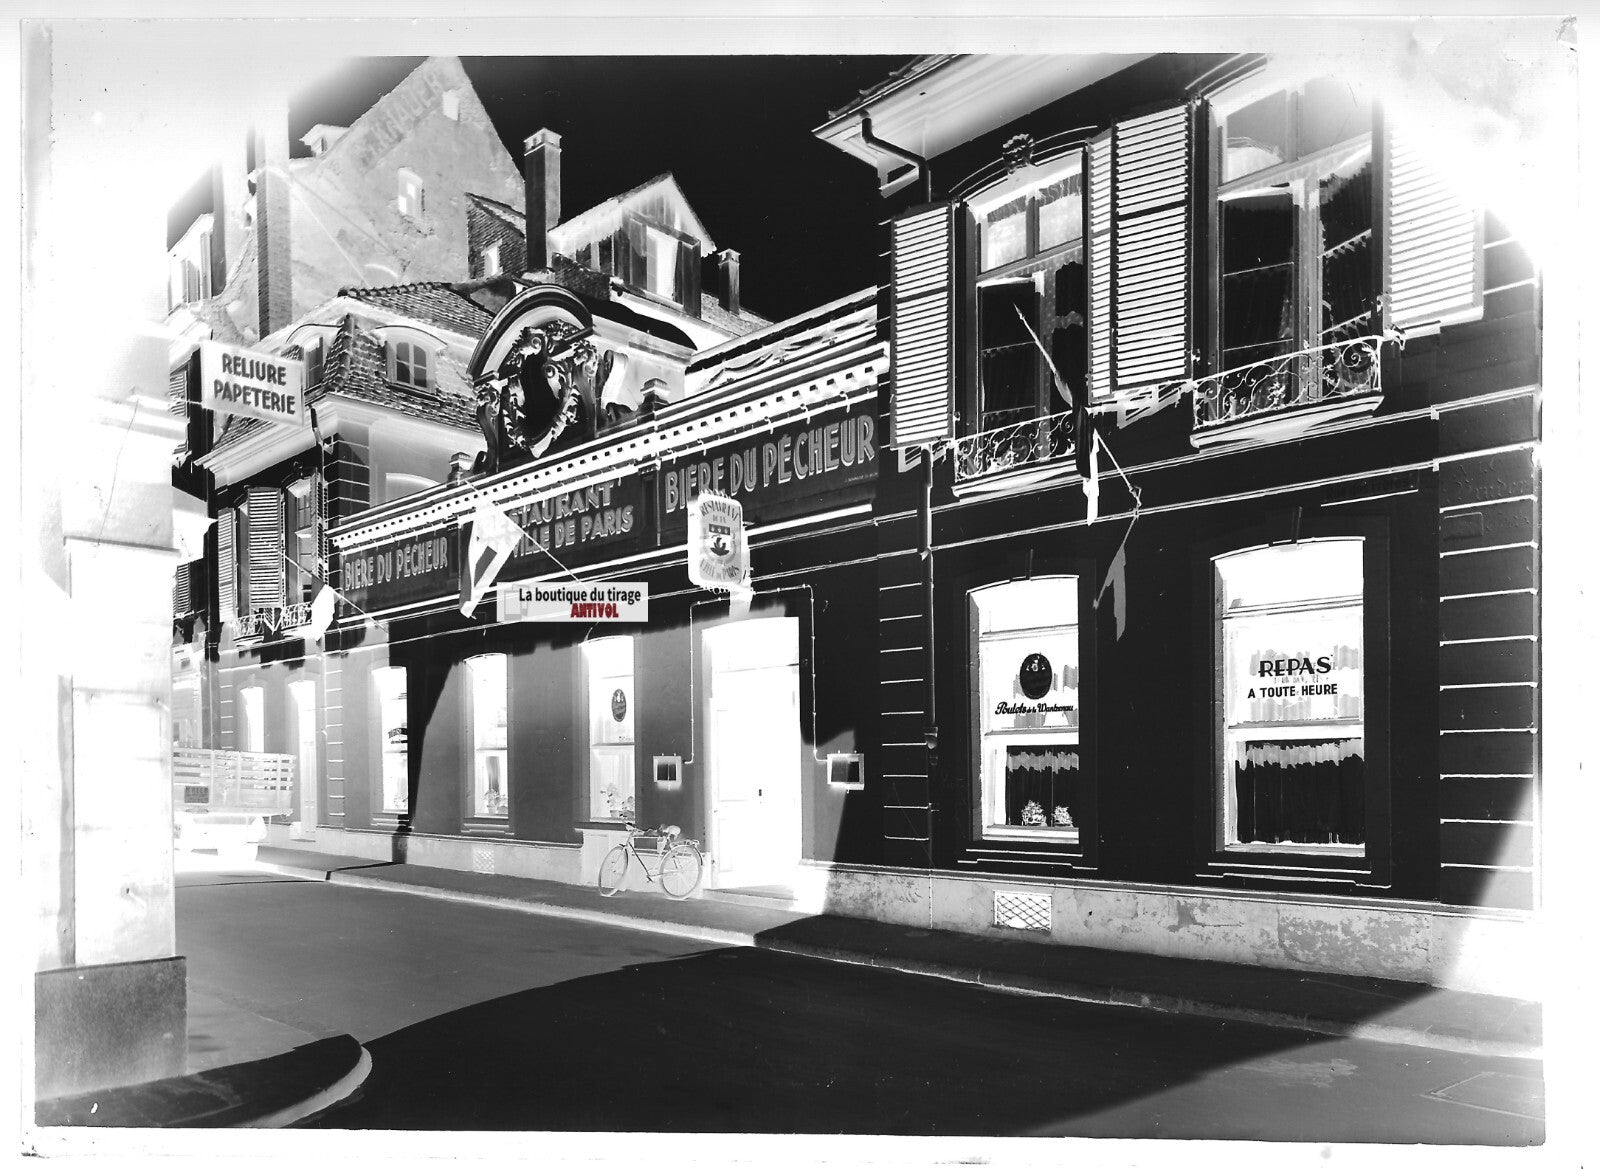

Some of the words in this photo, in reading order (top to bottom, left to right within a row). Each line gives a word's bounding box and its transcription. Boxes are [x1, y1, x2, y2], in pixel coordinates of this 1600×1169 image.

[222, 352, 287, 386] RELIURE
[213, 379, 296, 415] PAPETERIE
[729, 447, 757, 497] DU
[508, 482, 614, 529] STAURANT
[554, 519, 576, 549] DE
[580, 504, 634, 543] PARIS
[376, 551, 393, 584] DU
[1258, 656, 1332, 678] REPAS
[994, 701, 1027, 715] Poulets
[1247, 687, 1256, 699] A
[1259, 685, 1296, 698] TOUTE
[1301, 683, 1338, 696] HEURE
